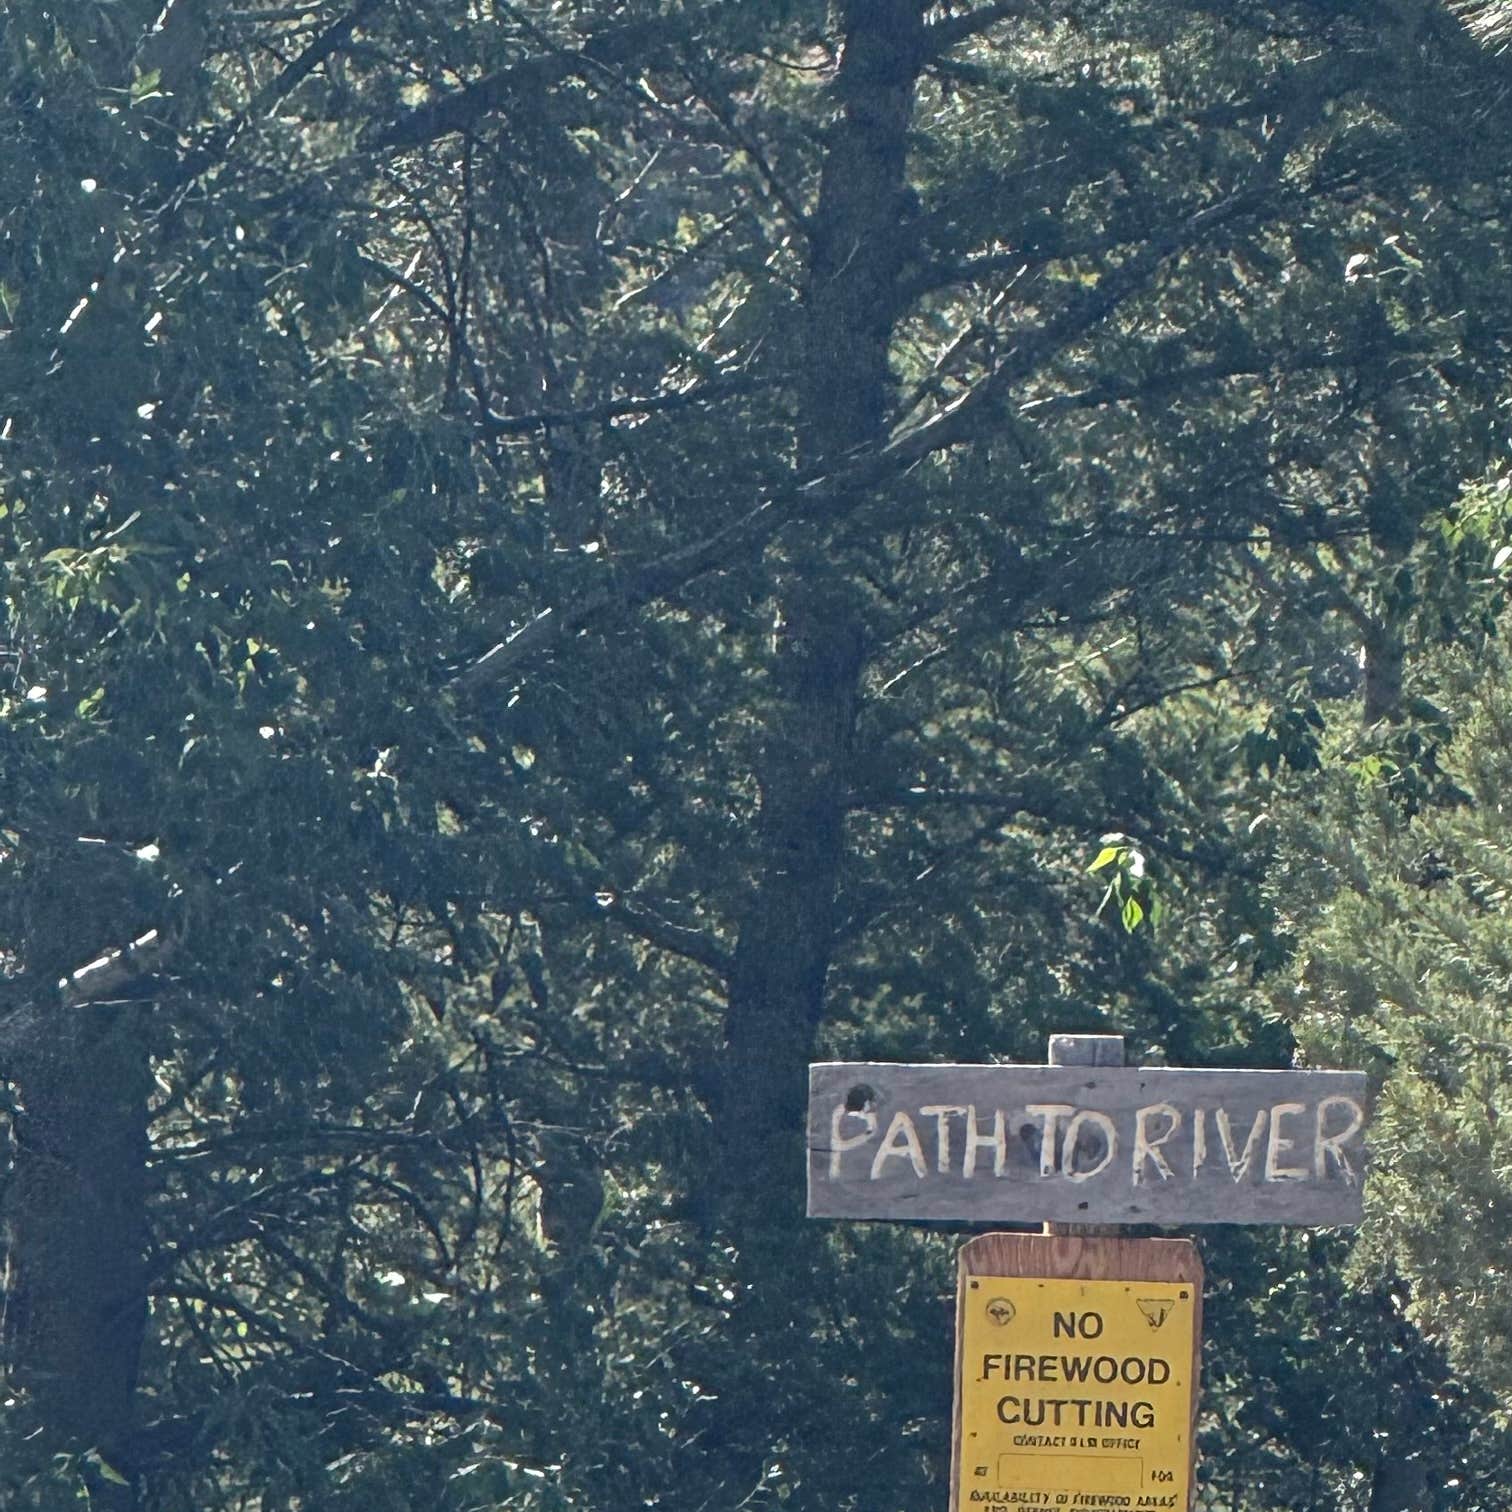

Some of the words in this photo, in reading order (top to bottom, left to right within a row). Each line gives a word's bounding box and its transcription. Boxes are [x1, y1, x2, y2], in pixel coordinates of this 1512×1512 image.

[828, 1102, 1007, 1181] PATH
[1025, 1102, 1118, 1184] TO
[1131, 1096, 1366, 1188] RIVER
[1053, 1311, 1104, 1340] NO
[982, 1353, 1171, 1386] FIREWOOD
[996, 1395, 1155, 1429] CUTTING
[1012, 1434, 1067, 1448] CONTACT
